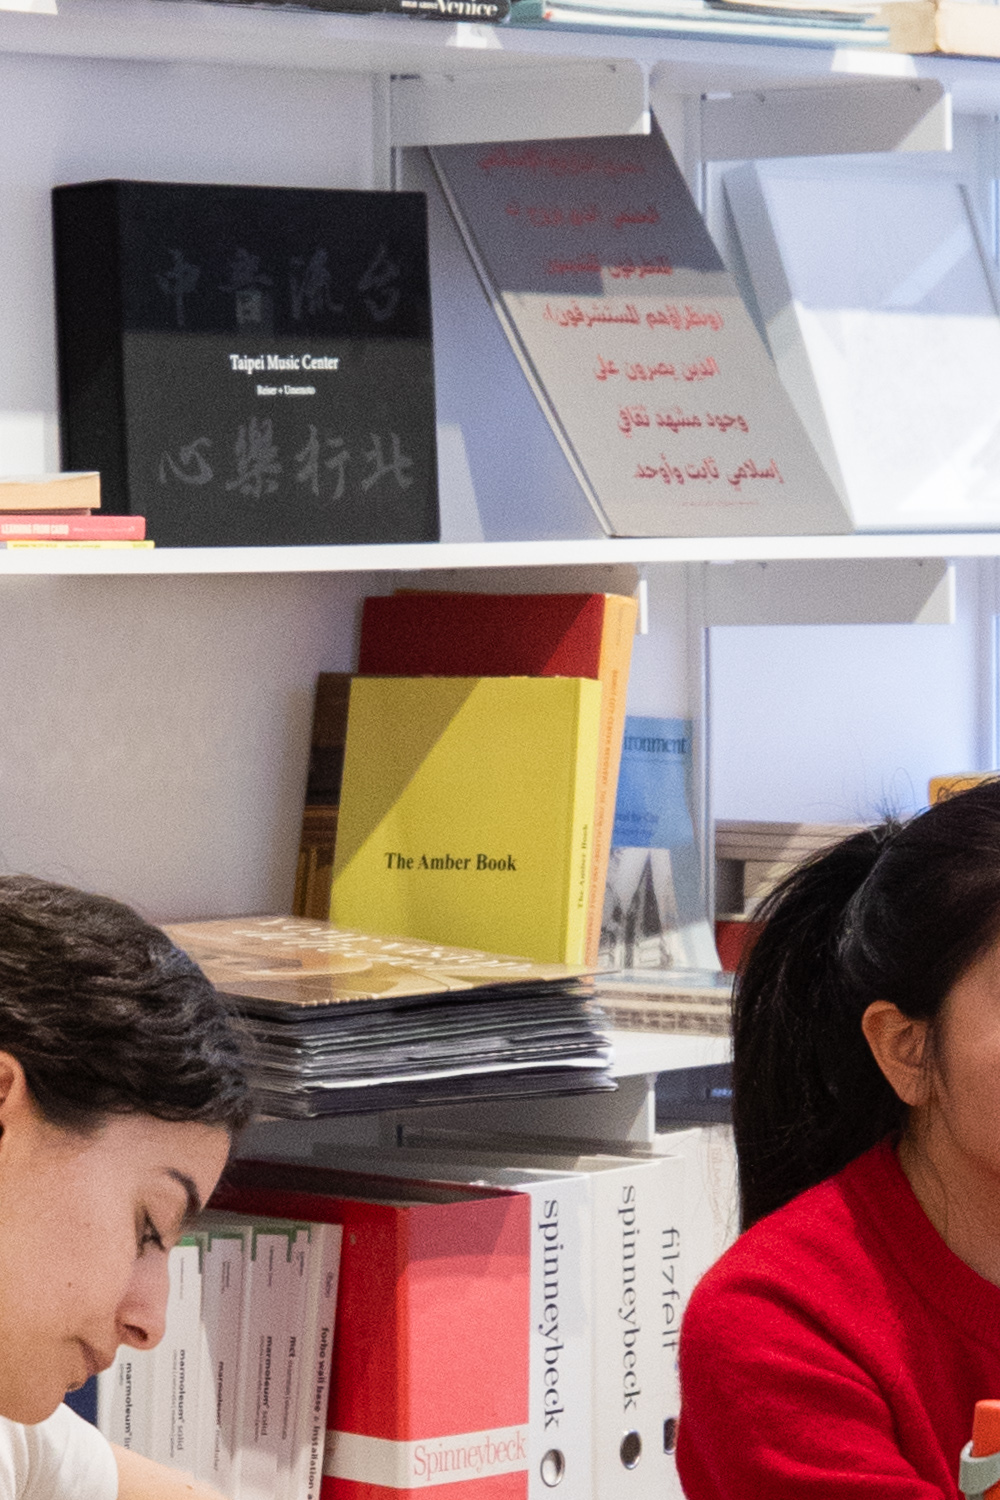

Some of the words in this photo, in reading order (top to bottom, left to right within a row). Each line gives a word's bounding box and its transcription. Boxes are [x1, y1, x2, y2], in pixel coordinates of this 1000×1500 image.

[229, 354, 265, 375] Taipei
[266, 354, 300, 372] Music
[300, 355, 340, 371] Center
[384, 851, 414, 873] The
[417, 851, 473, 873] Amber
[476, 852, 518, 874] Book
[618, 1185, 644, 1412] spinneybeck
[661, 1227, 680, 1352] filzfelt
[538, 1199, 565, 1431] spinneybeck
[318, 1326, 330, 1358] forbo
[315, 1361, 327, 1384] wall
[313, 1386, 325, 1412] base
[176, 1425, 186, 1451] solid
[260, 1410, 271, 1437] solid
[307, 1425, 321, 1489] installation
[412, 1434, 527, 1479] Spinneybeck
